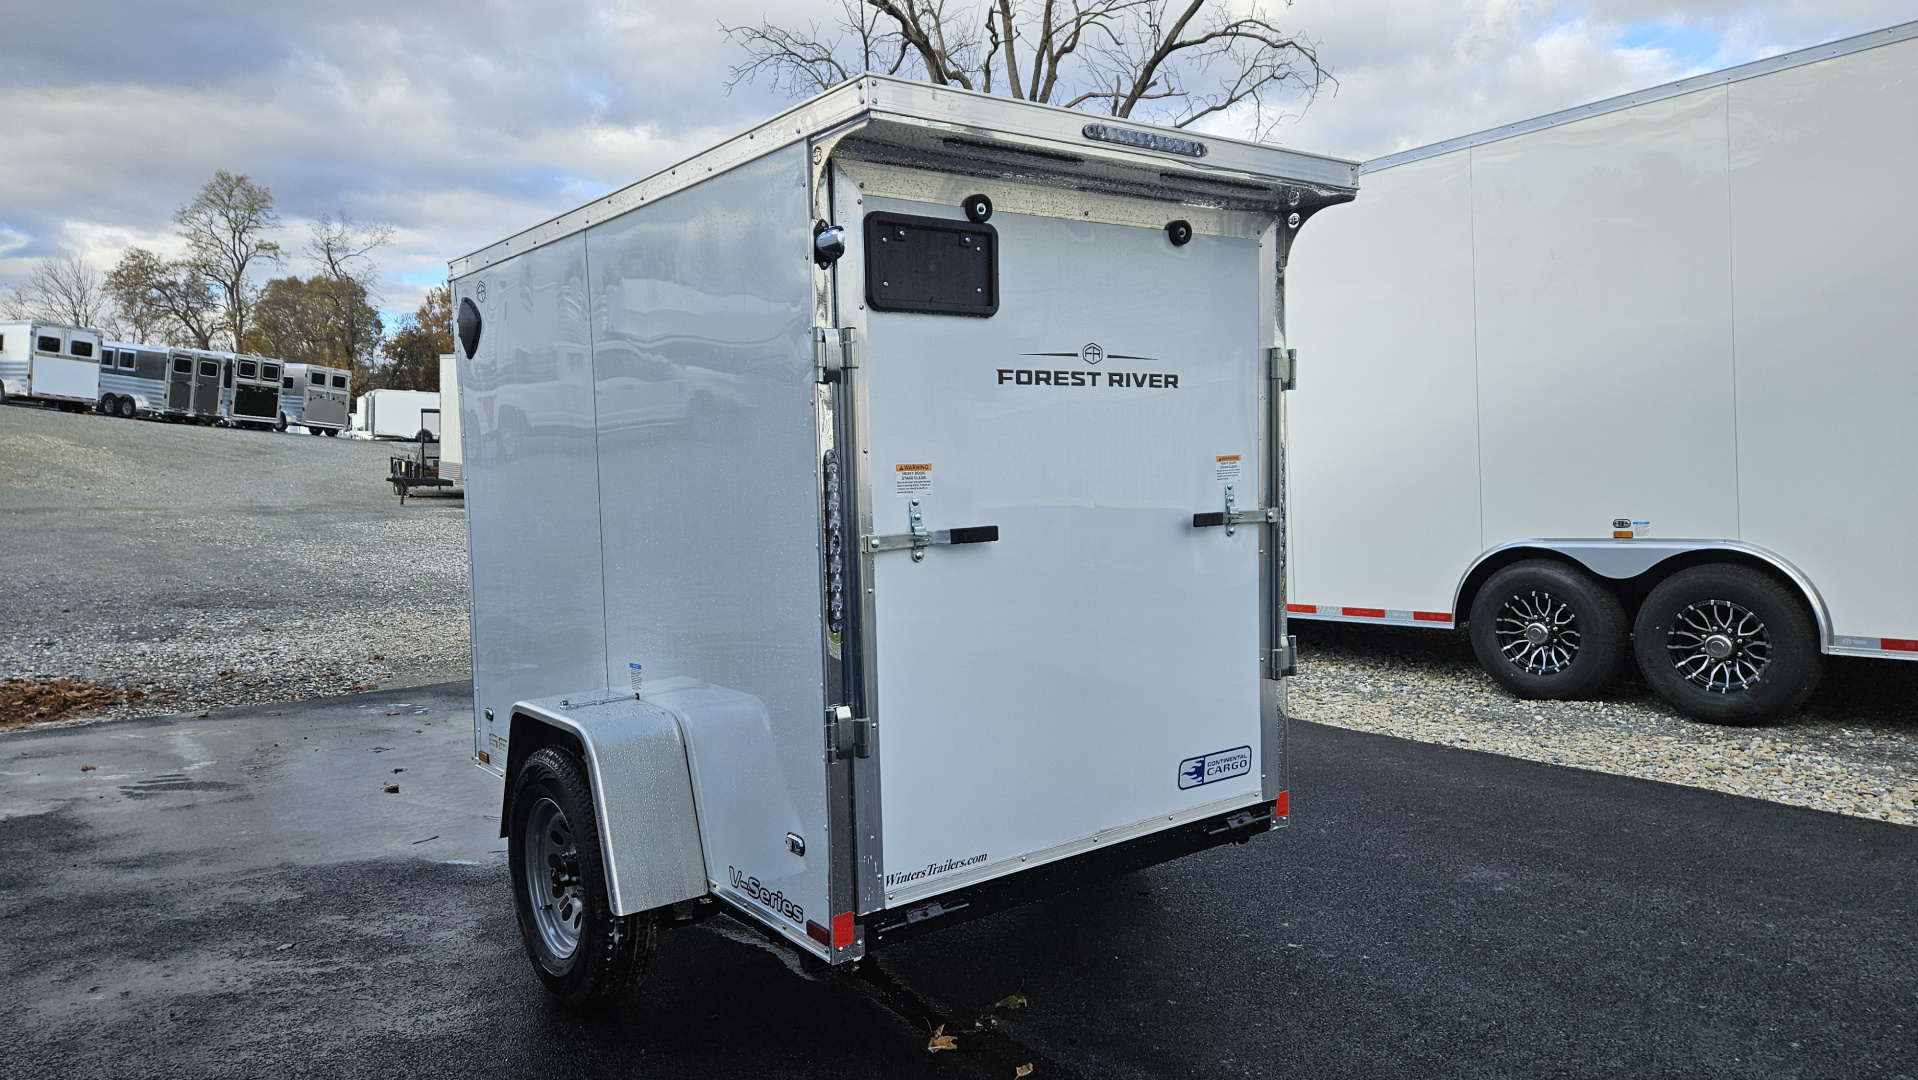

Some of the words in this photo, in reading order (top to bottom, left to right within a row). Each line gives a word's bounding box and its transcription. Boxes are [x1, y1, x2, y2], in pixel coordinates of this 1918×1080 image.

[996, 369, 1102, 387] FOREST
[1107, 371, 1179, 389] RIVER
[1207, 753, 1247, 767] CONTINENTAL
[1207, 760, 1248, 776] CARGO
[885, 853, 988, 888] WintersTrailers.com
[729, 865, 804, 924] V-Series
